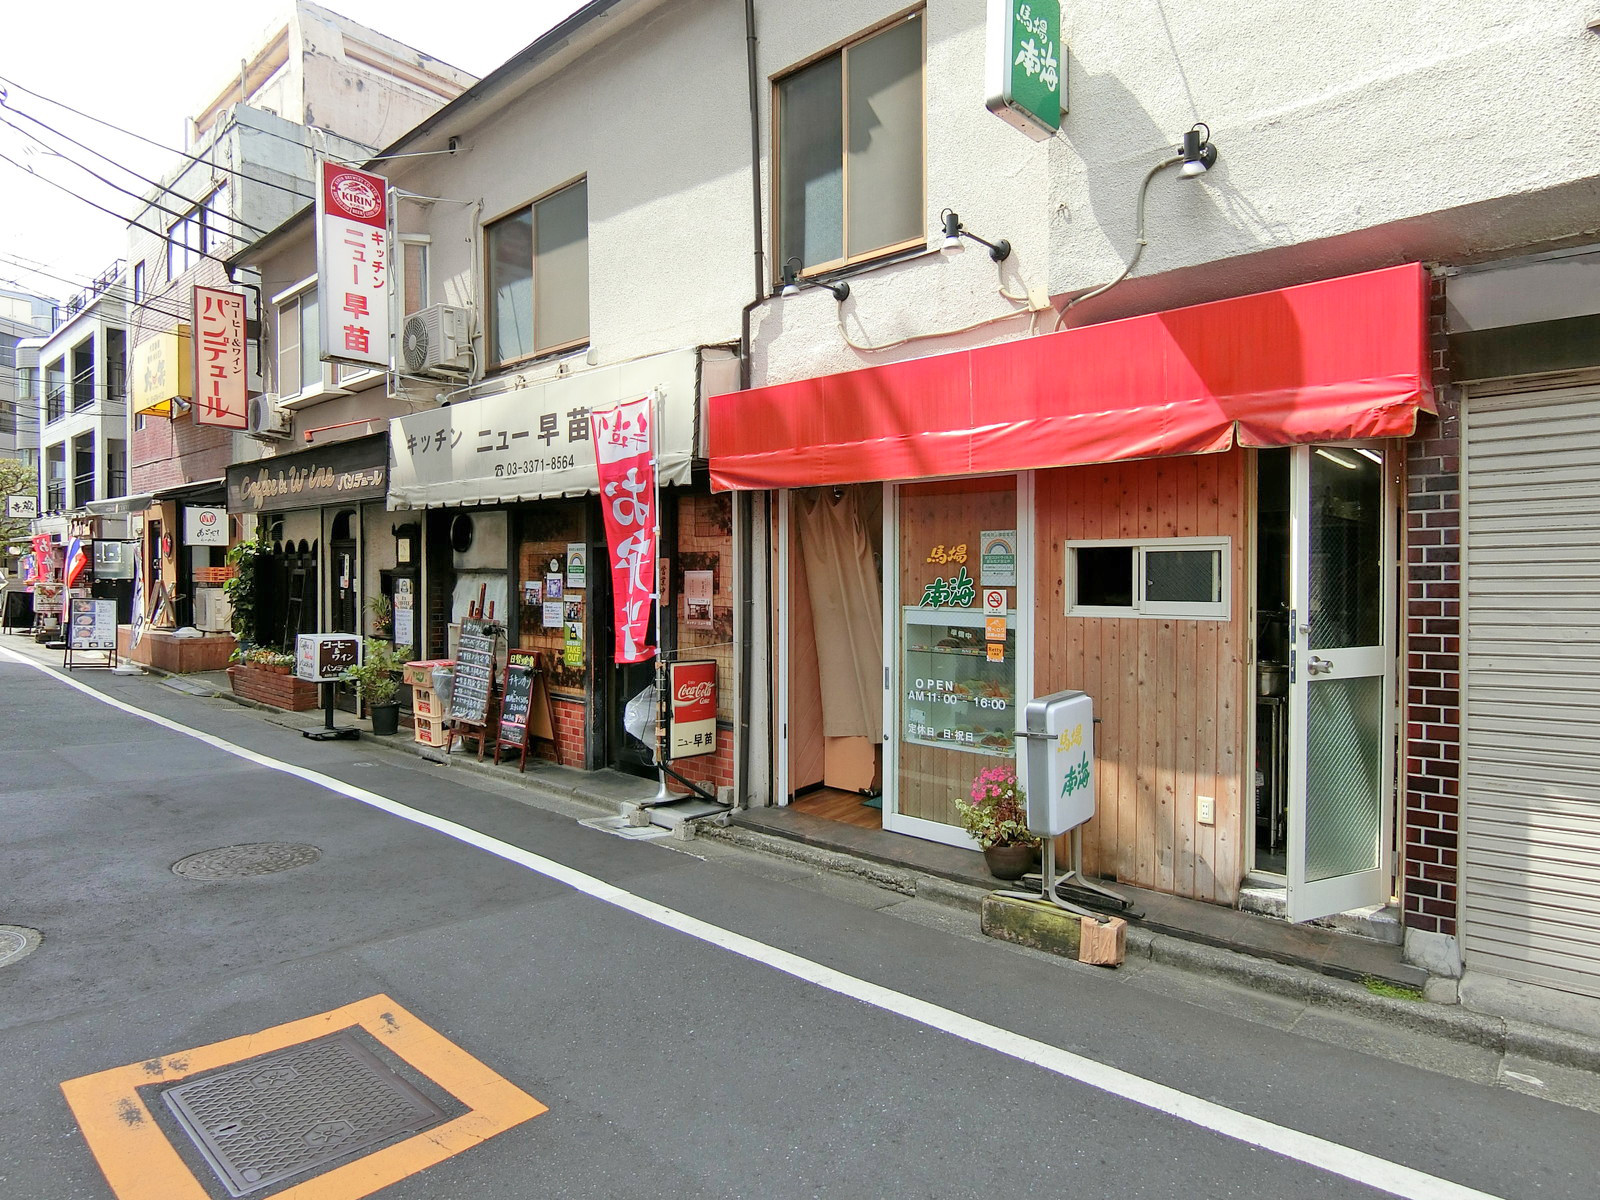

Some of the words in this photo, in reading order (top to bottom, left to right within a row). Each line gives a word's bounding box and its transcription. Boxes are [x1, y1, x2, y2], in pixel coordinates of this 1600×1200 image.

[1016, 4, 1048, 44] 馬場
[1014, 38, 1059, 92] 南海
[341, 191, 373, 208] KIRIN
[371, 231, 385, 289] キッチン
[343, 228, 370, 354] ニュー早苗
[231, 301, 242, 374] コーヒー&ワイン
[203, 296, 230, 418] パンデュール
[407, 426, 463, 456] キッチン
[506, 454, 575, 476] 03-3371-8564
[240, 467, 278, 509] Coffee
[288, 464, 336, 493] Wine
[337, 470, 383, 491] パンデュール
[927, 543, 968, 564] 馬場
[919, 566, 975, 608] 南海
[323, 640, 352, 649] コーヒー
[566, 645, 581, 654] TAKE
[567, 654, 580, 662] OUT
[677, 681, 715, 700] Coca-Cola
[915, 678, 954, 692] OPEN
[699, 697, 710, 705] Coke
[908, 690, 925, 702] AM
[973, 696, 1006, 711] 16:00
[677, 731, 713, 748] ニュー早苗
[908, 723, 934, 737] 定休日
[1057, 723, 1083, 753] 馬場
[1060, 750, 1090, 799] 南海
